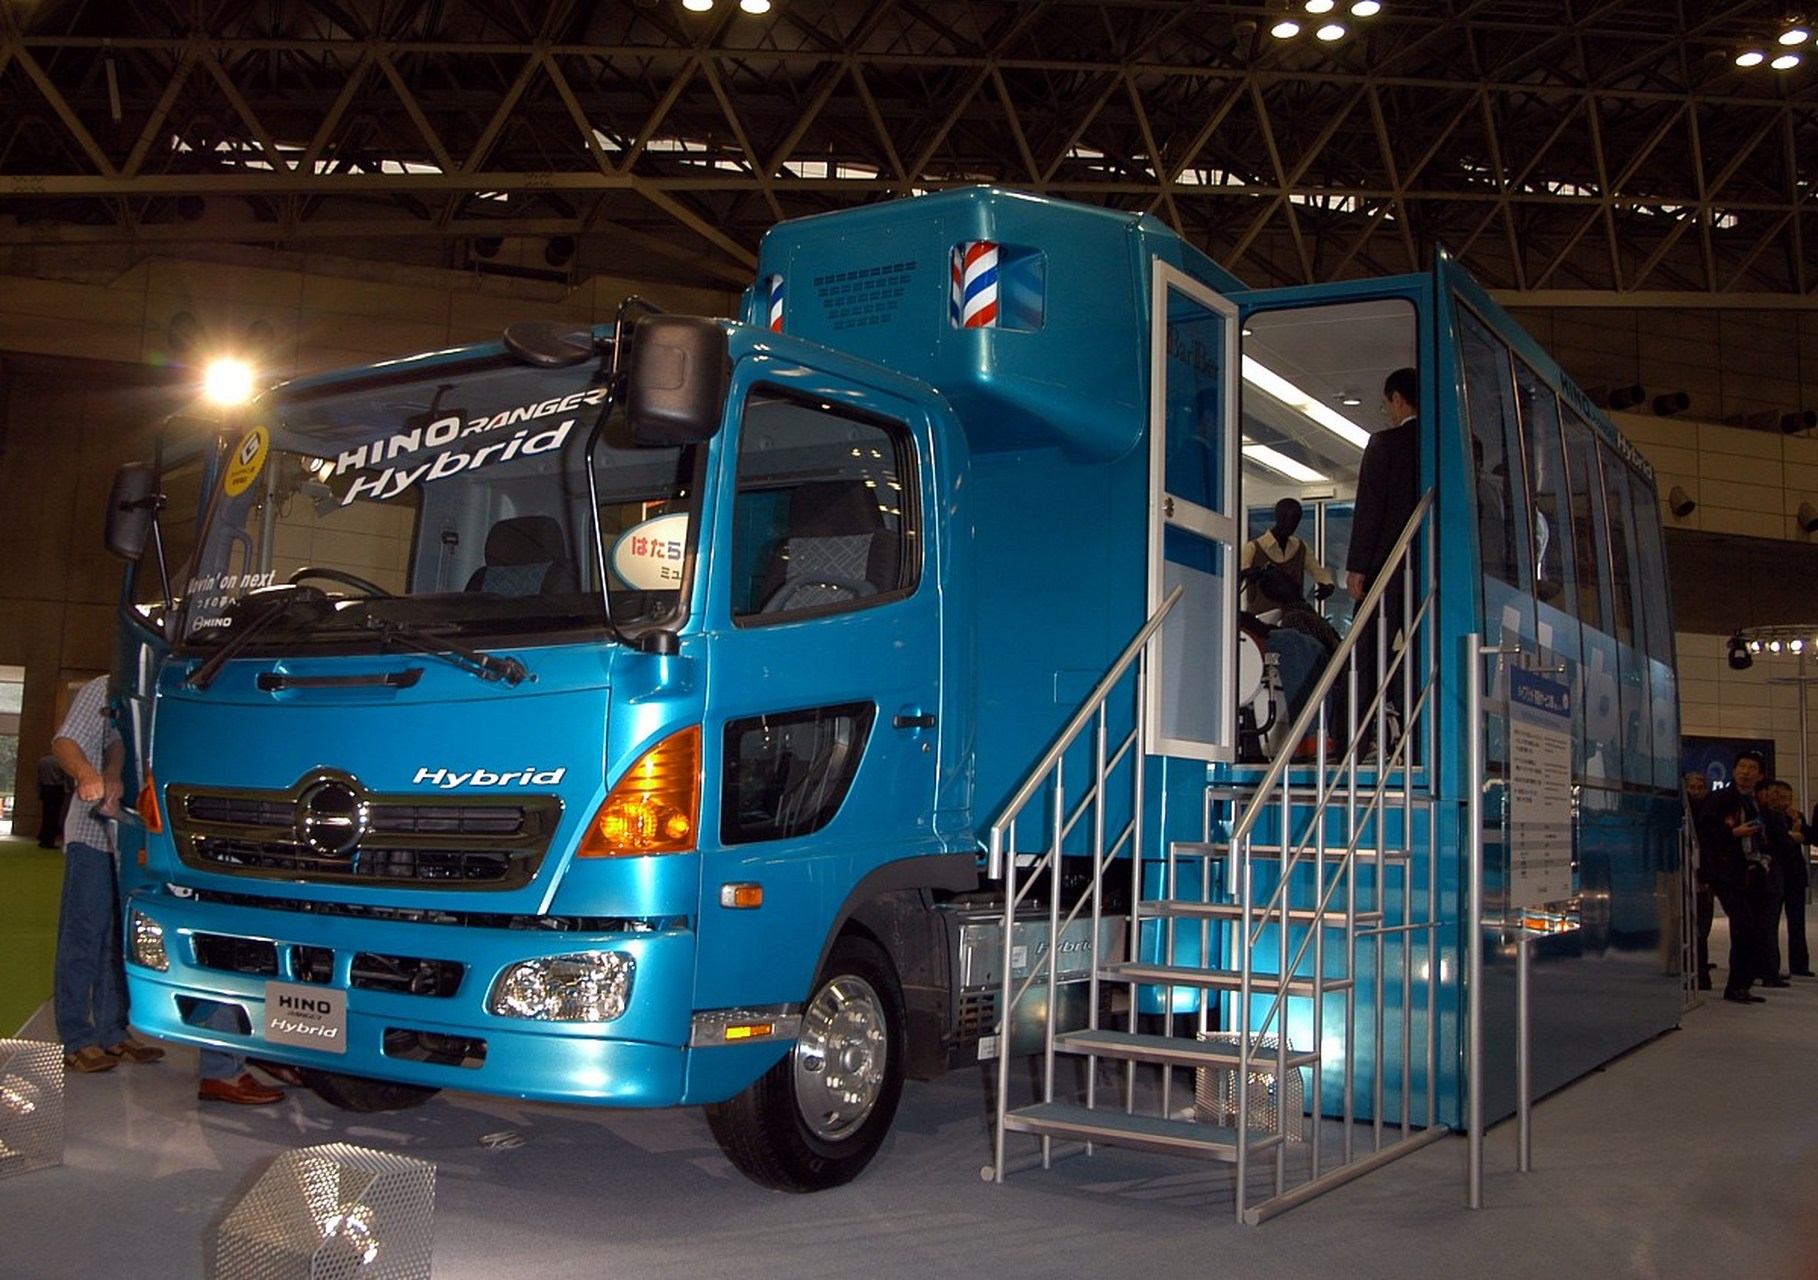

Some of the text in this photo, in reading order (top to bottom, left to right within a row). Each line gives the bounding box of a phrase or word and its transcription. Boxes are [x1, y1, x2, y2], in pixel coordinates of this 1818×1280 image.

[335, 387, 608, 476] HINO RANGER
[341, 419, 576, 507] Hybrid
[239, 569, 277, 589] next
[202, 617, 232, 628] HINO
[412, 767, 566, 788] Hybrid
[279, 994, 331, 1015] HINO
[270, 1018, 338, 1038] Hybrid
